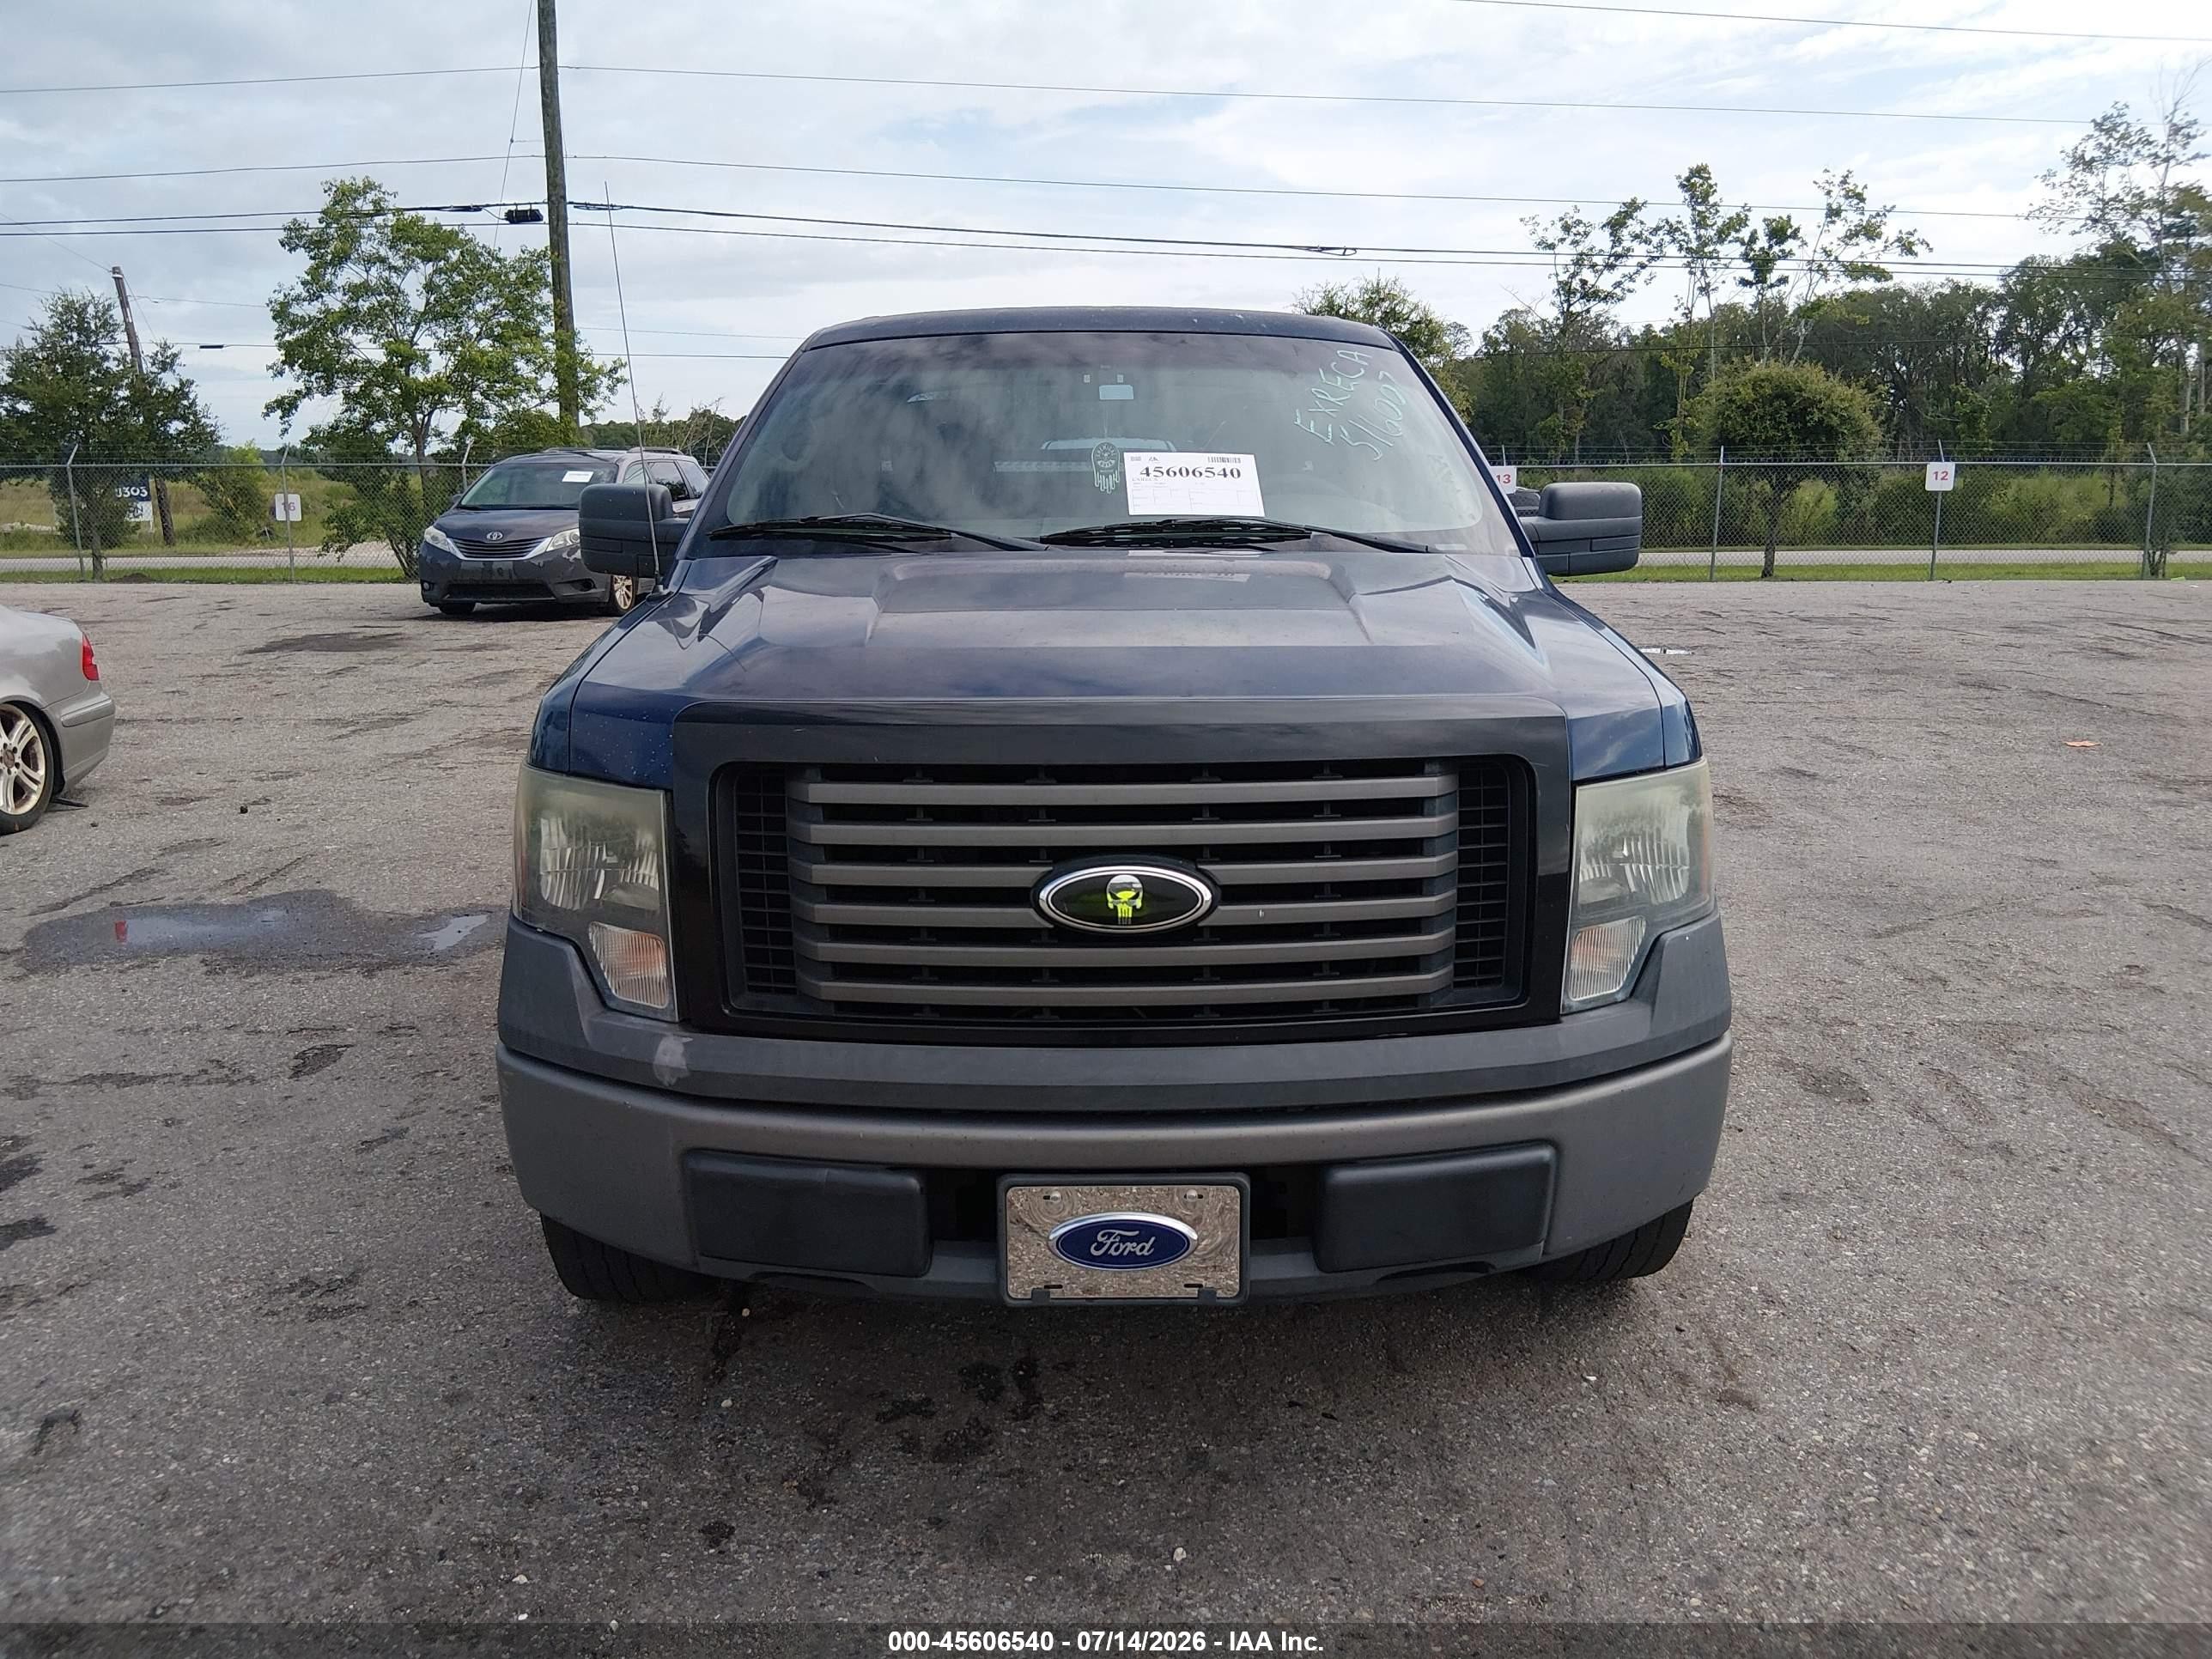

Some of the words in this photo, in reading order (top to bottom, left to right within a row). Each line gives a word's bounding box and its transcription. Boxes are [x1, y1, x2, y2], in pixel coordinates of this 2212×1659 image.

[1139, 465, 1242, 479] 45606540
[1933, 471, 1948, 481] 12
[1496, 473, 1511, 484] 13
[1090, 1229, 1156, 1256] Ford
